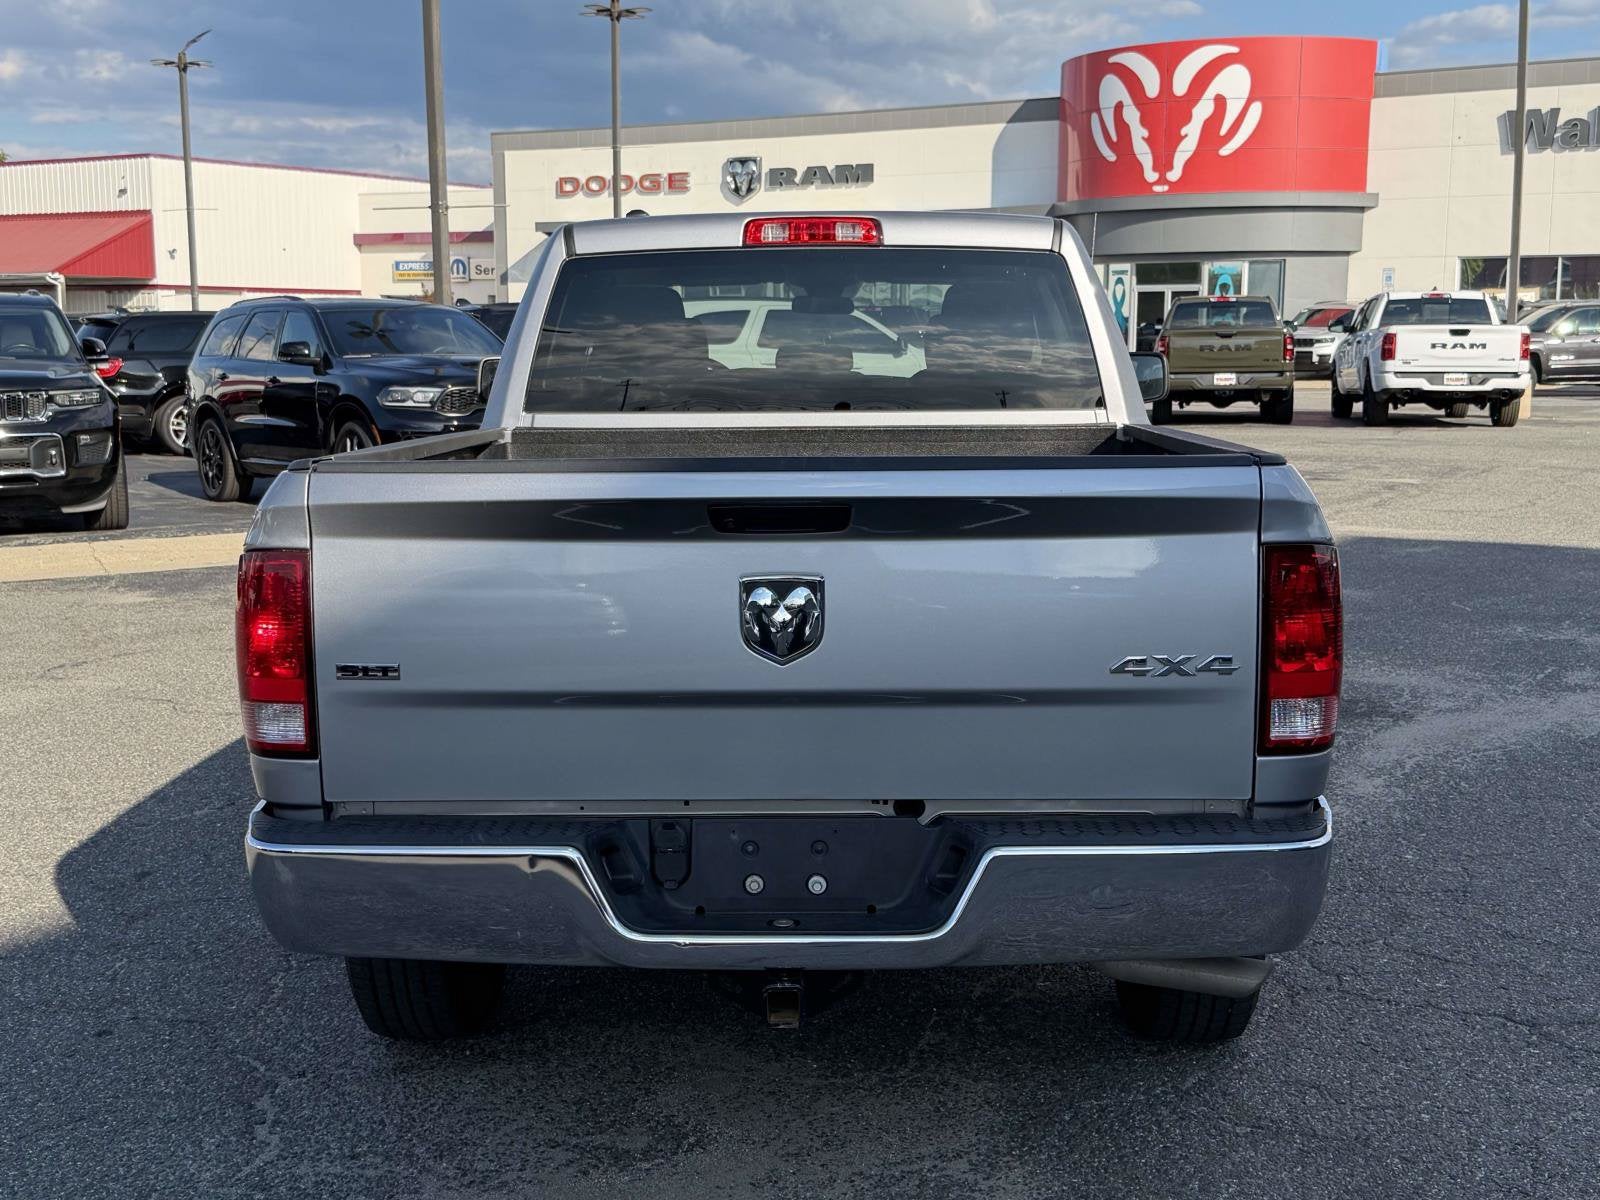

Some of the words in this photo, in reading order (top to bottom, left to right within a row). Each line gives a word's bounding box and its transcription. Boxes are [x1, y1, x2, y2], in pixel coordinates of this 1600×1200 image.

[557, 171, 690, 197] DODGE
[767, 163, 875, 190] RAM
[399, 262, 430, 271] EXPRESS
[474, 264, 496, 276] Ser
[1199, 344, 1252, 352] RAM
[336, 663, 401, 681] SLT
